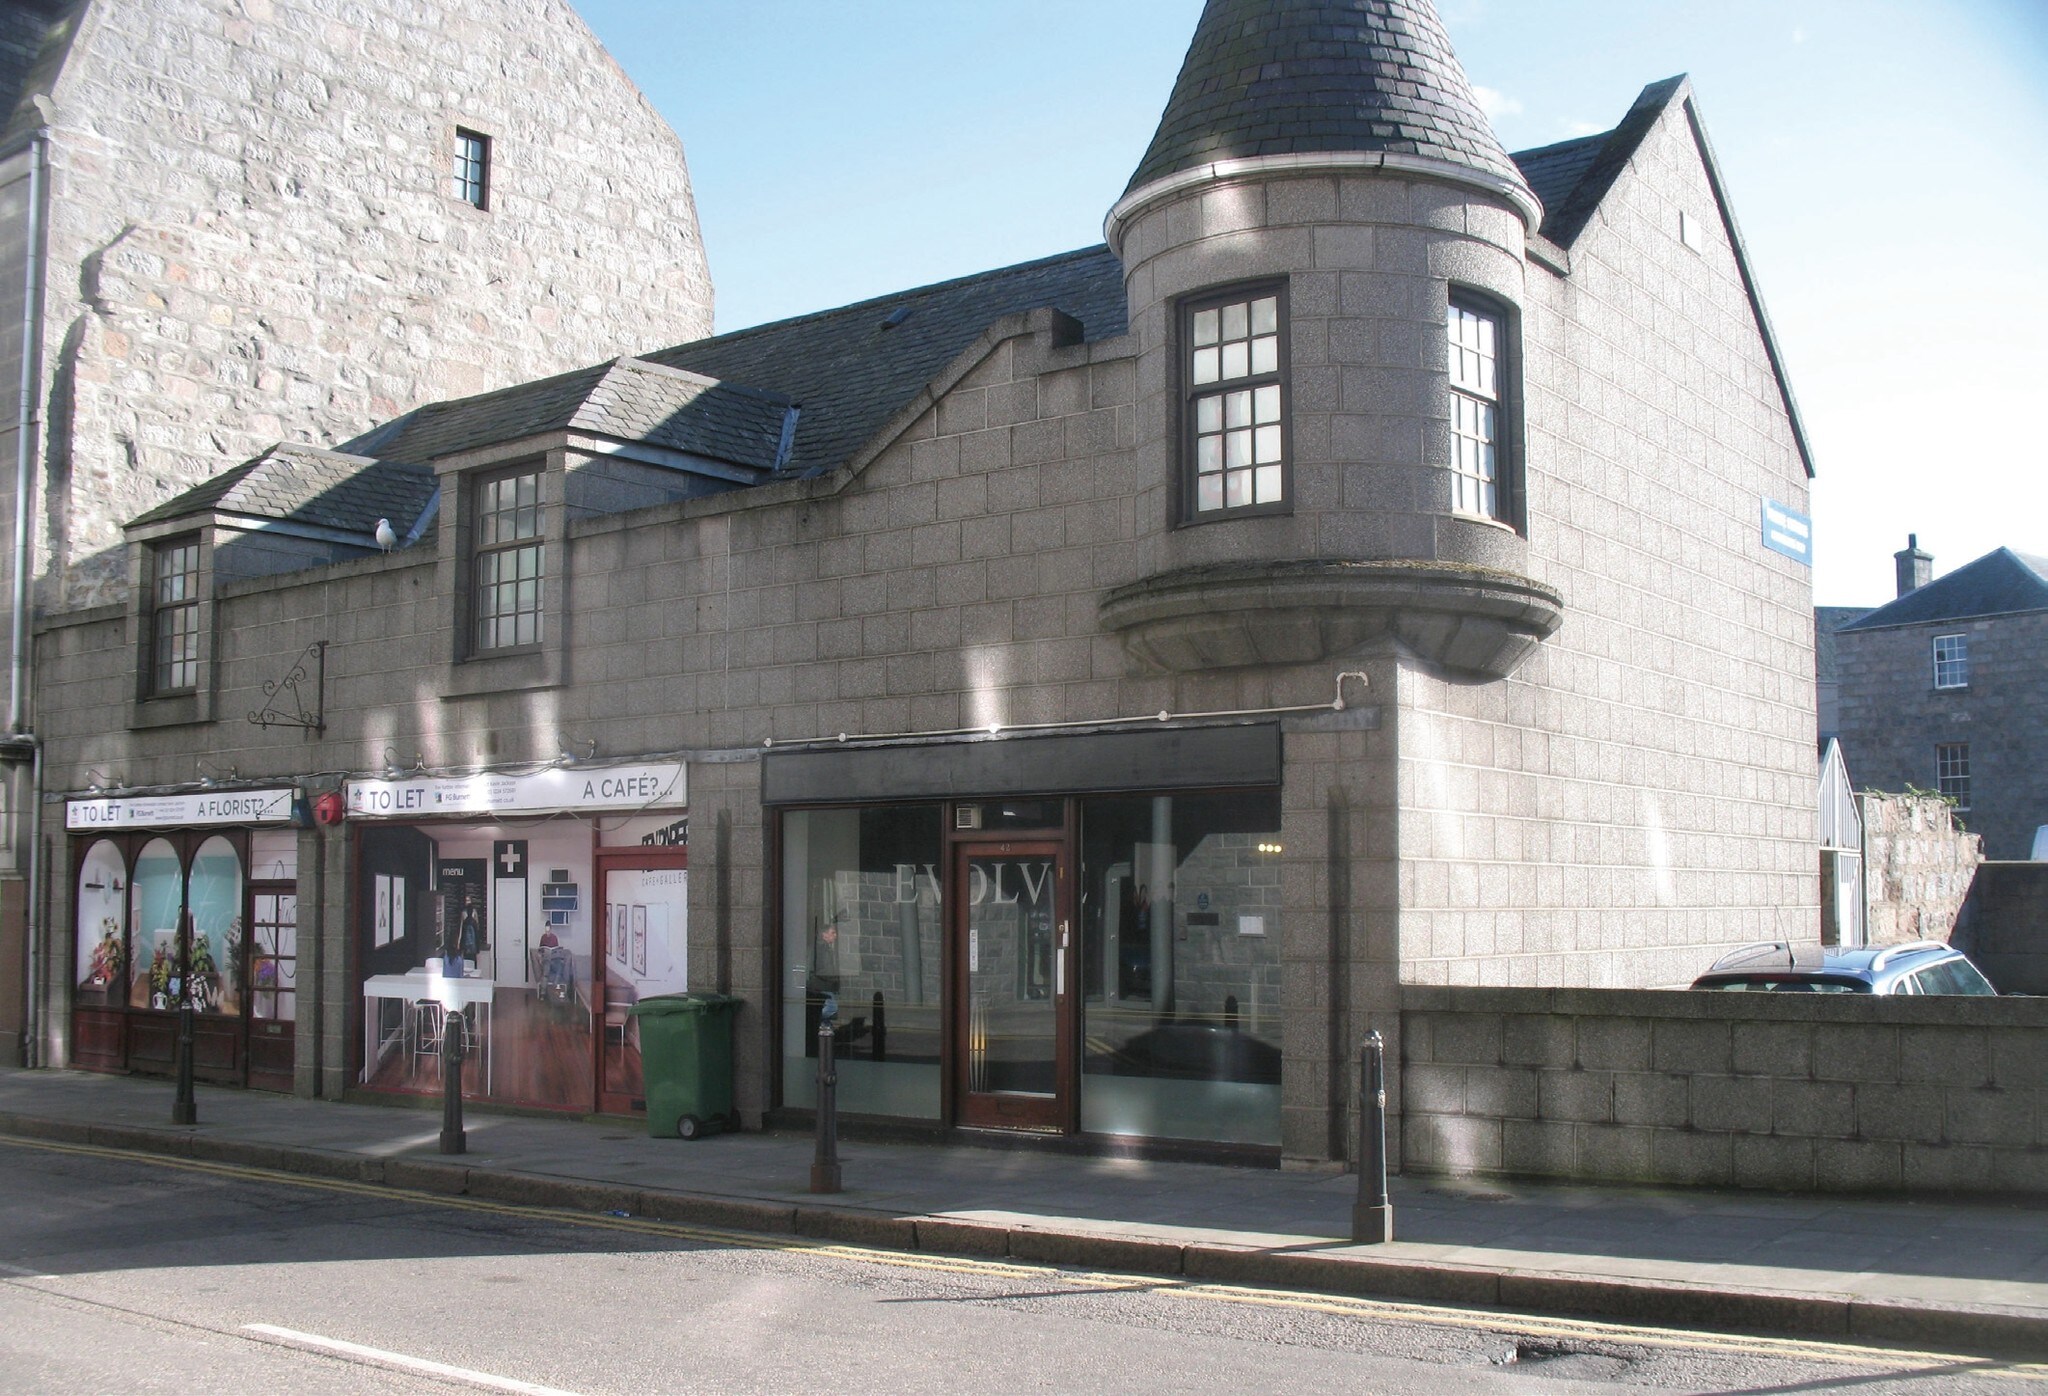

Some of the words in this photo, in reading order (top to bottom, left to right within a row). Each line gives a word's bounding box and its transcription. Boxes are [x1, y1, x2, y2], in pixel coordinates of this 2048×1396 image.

[369, 790, 391, 810] TO
[396, 788, 425, 809] LET
[582, 780, 595, 799] A
[82, 805, 97, 822] TO
[100, 804, 122, 821] LET
[197, 801, 206, 817] A
[893, 862, 1088, 905] EVOLV
